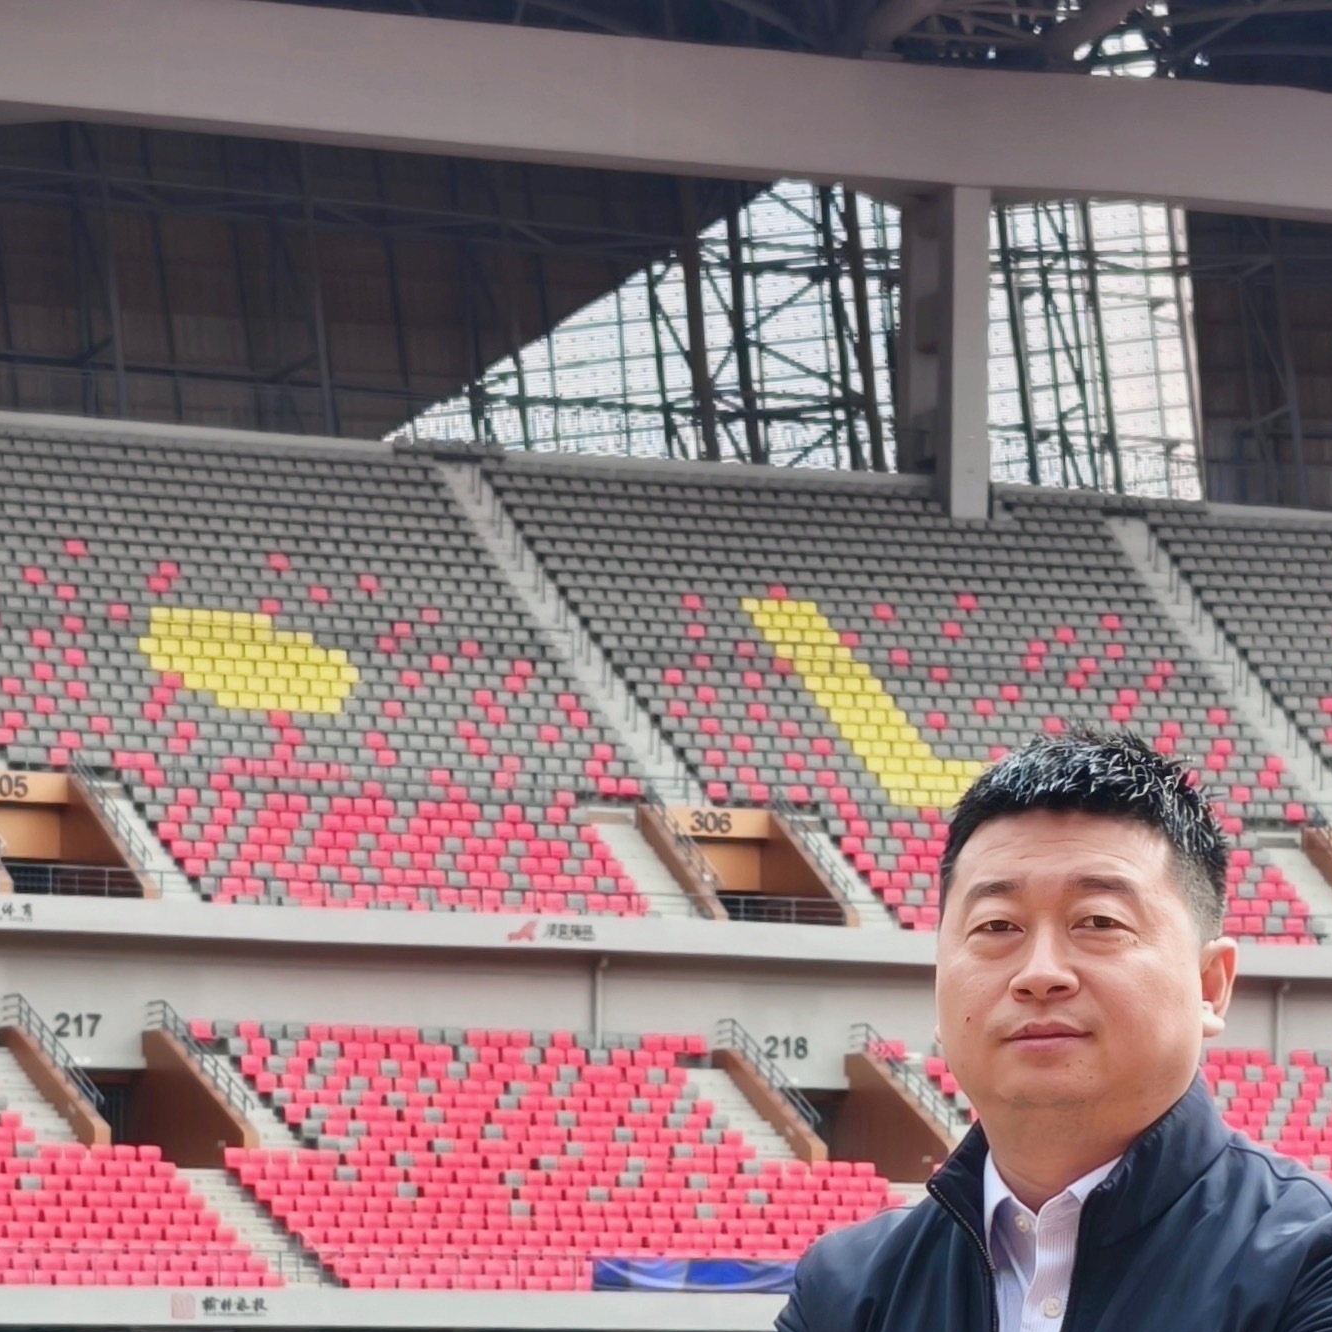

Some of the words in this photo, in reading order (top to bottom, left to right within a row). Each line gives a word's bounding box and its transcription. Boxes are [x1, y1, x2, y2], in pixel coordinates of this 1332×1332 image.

[689, 810, 733, 834] 306
[53, 1013, 102, 1039] 217
[762, 1035, 809, 1061] 218
